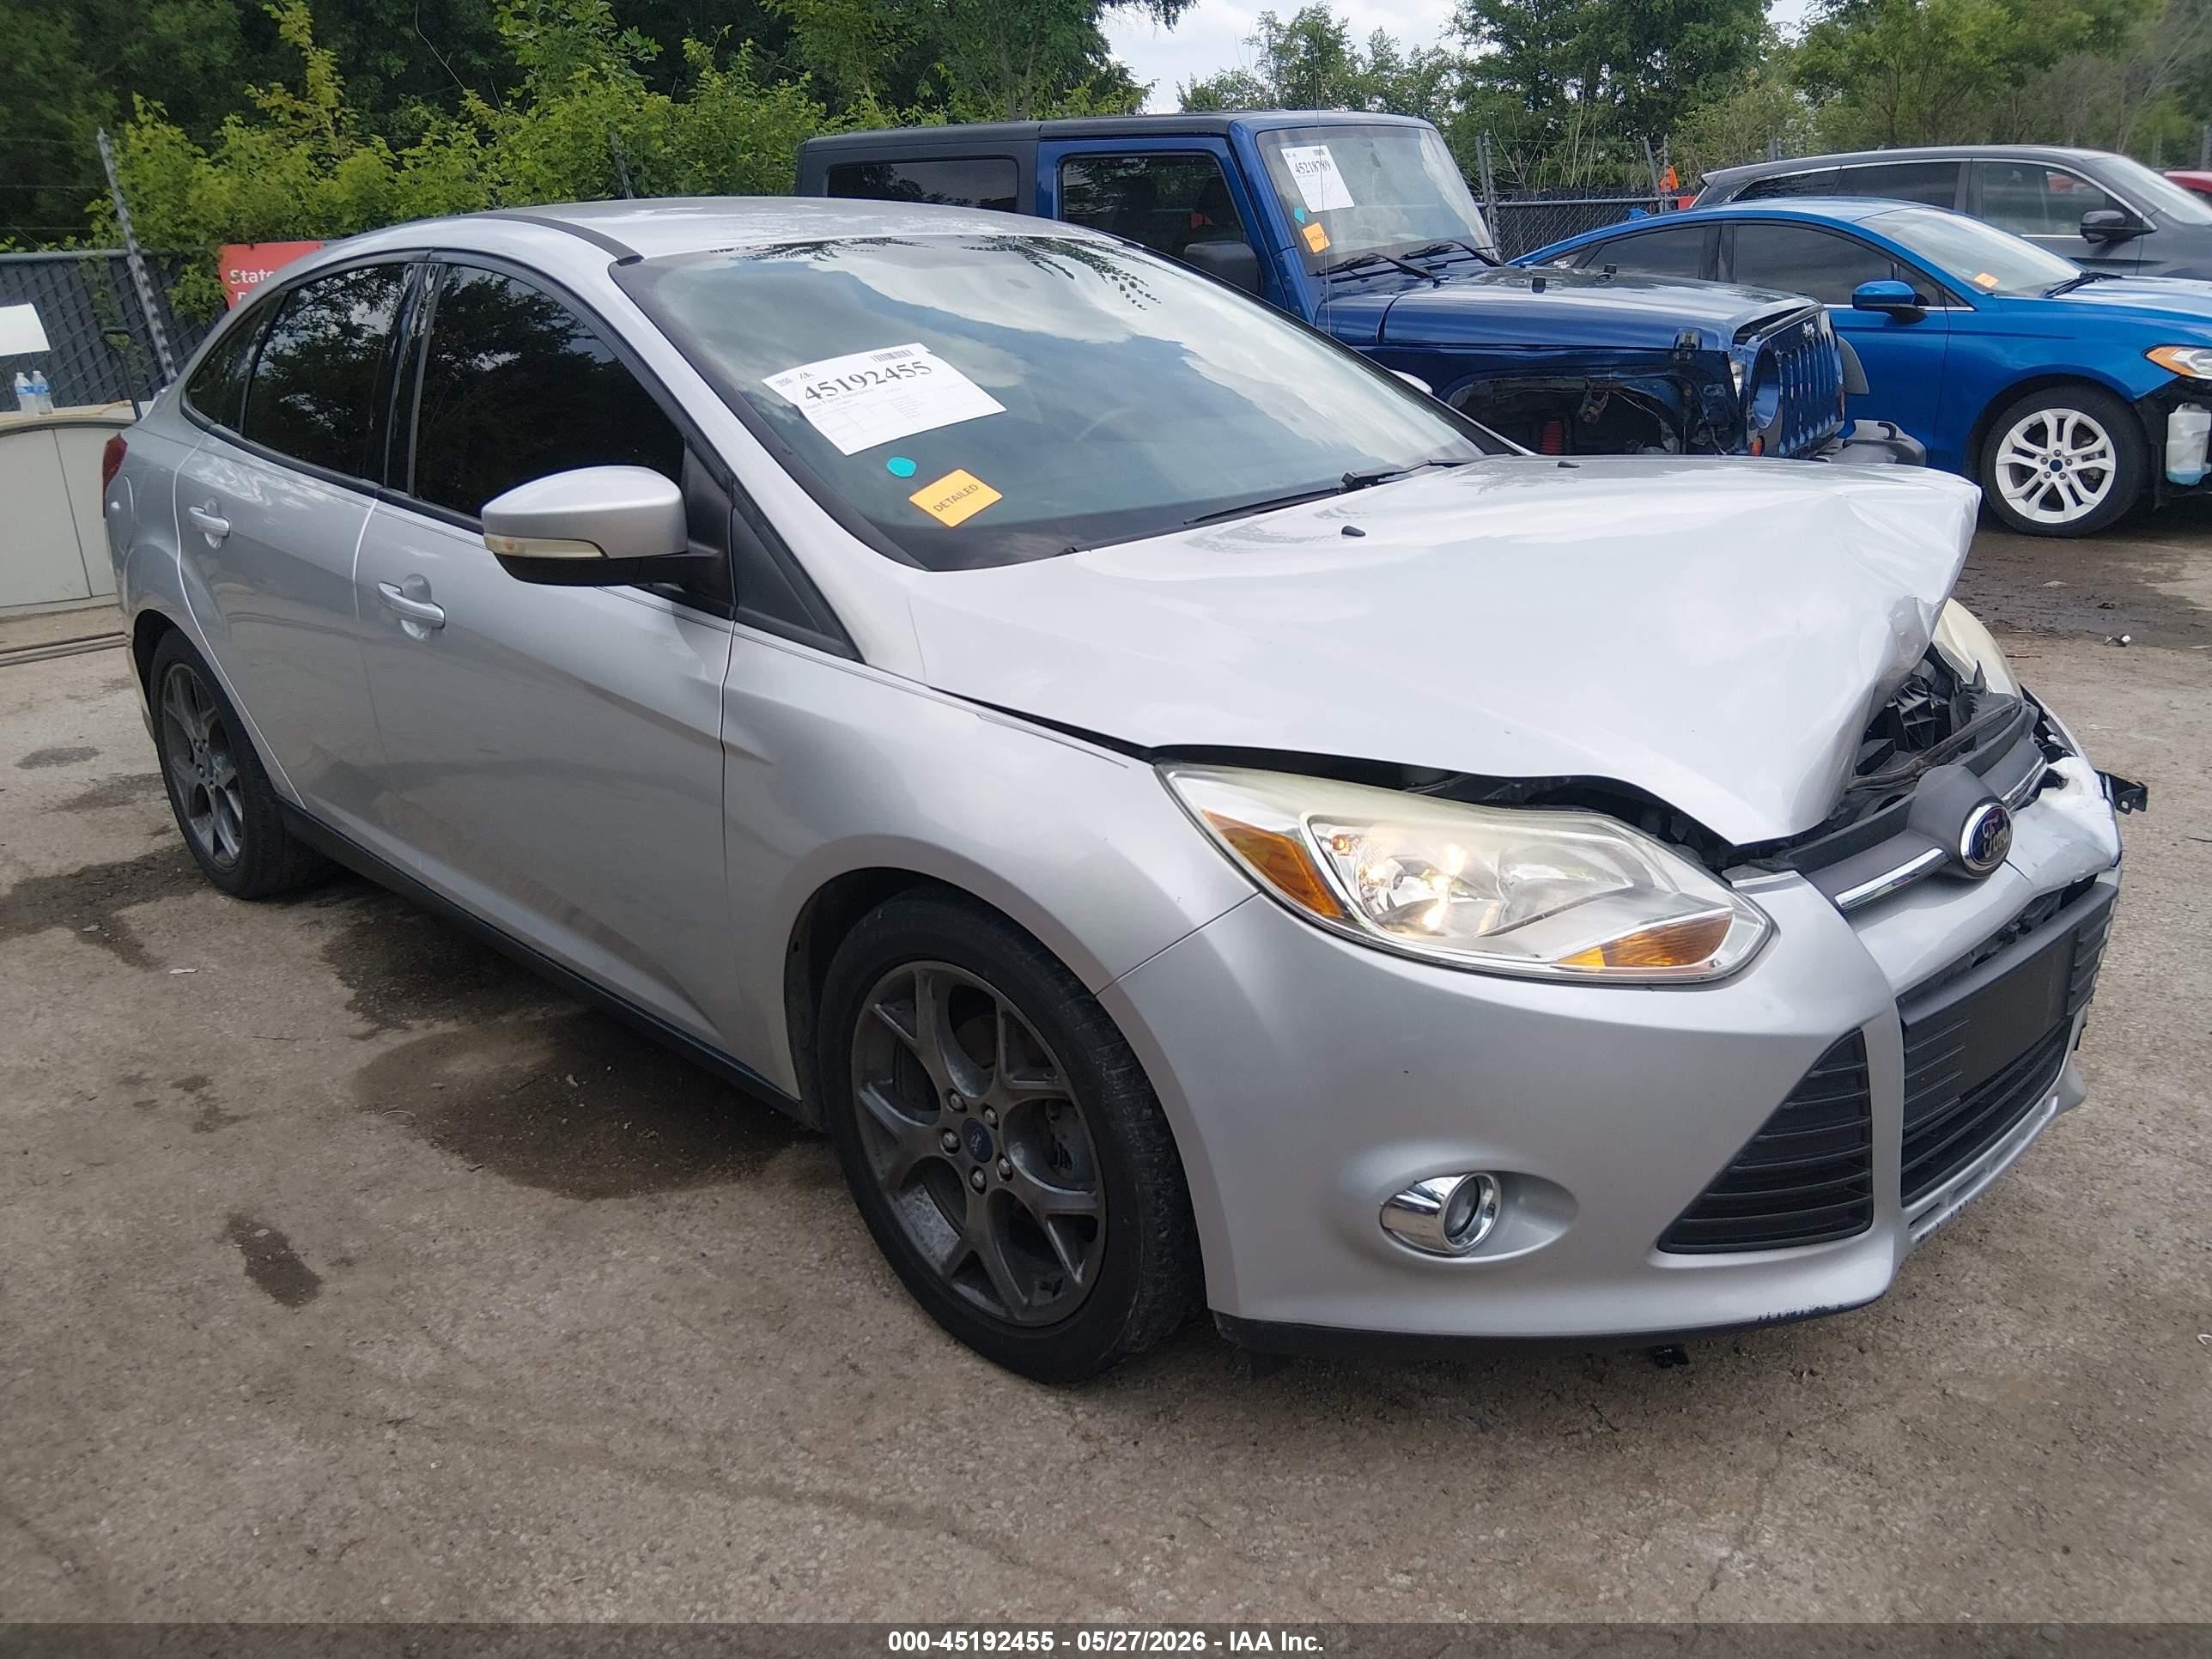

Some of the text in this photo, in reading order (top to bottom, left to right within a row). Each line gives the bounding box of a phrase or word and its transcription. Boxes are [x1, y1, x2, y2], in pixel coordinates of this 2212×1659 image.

[805, 361, 933, 400] 45192455
[933, 483, 979, 512] DETAILED
[1982, 811, 2008, 858] Ford
